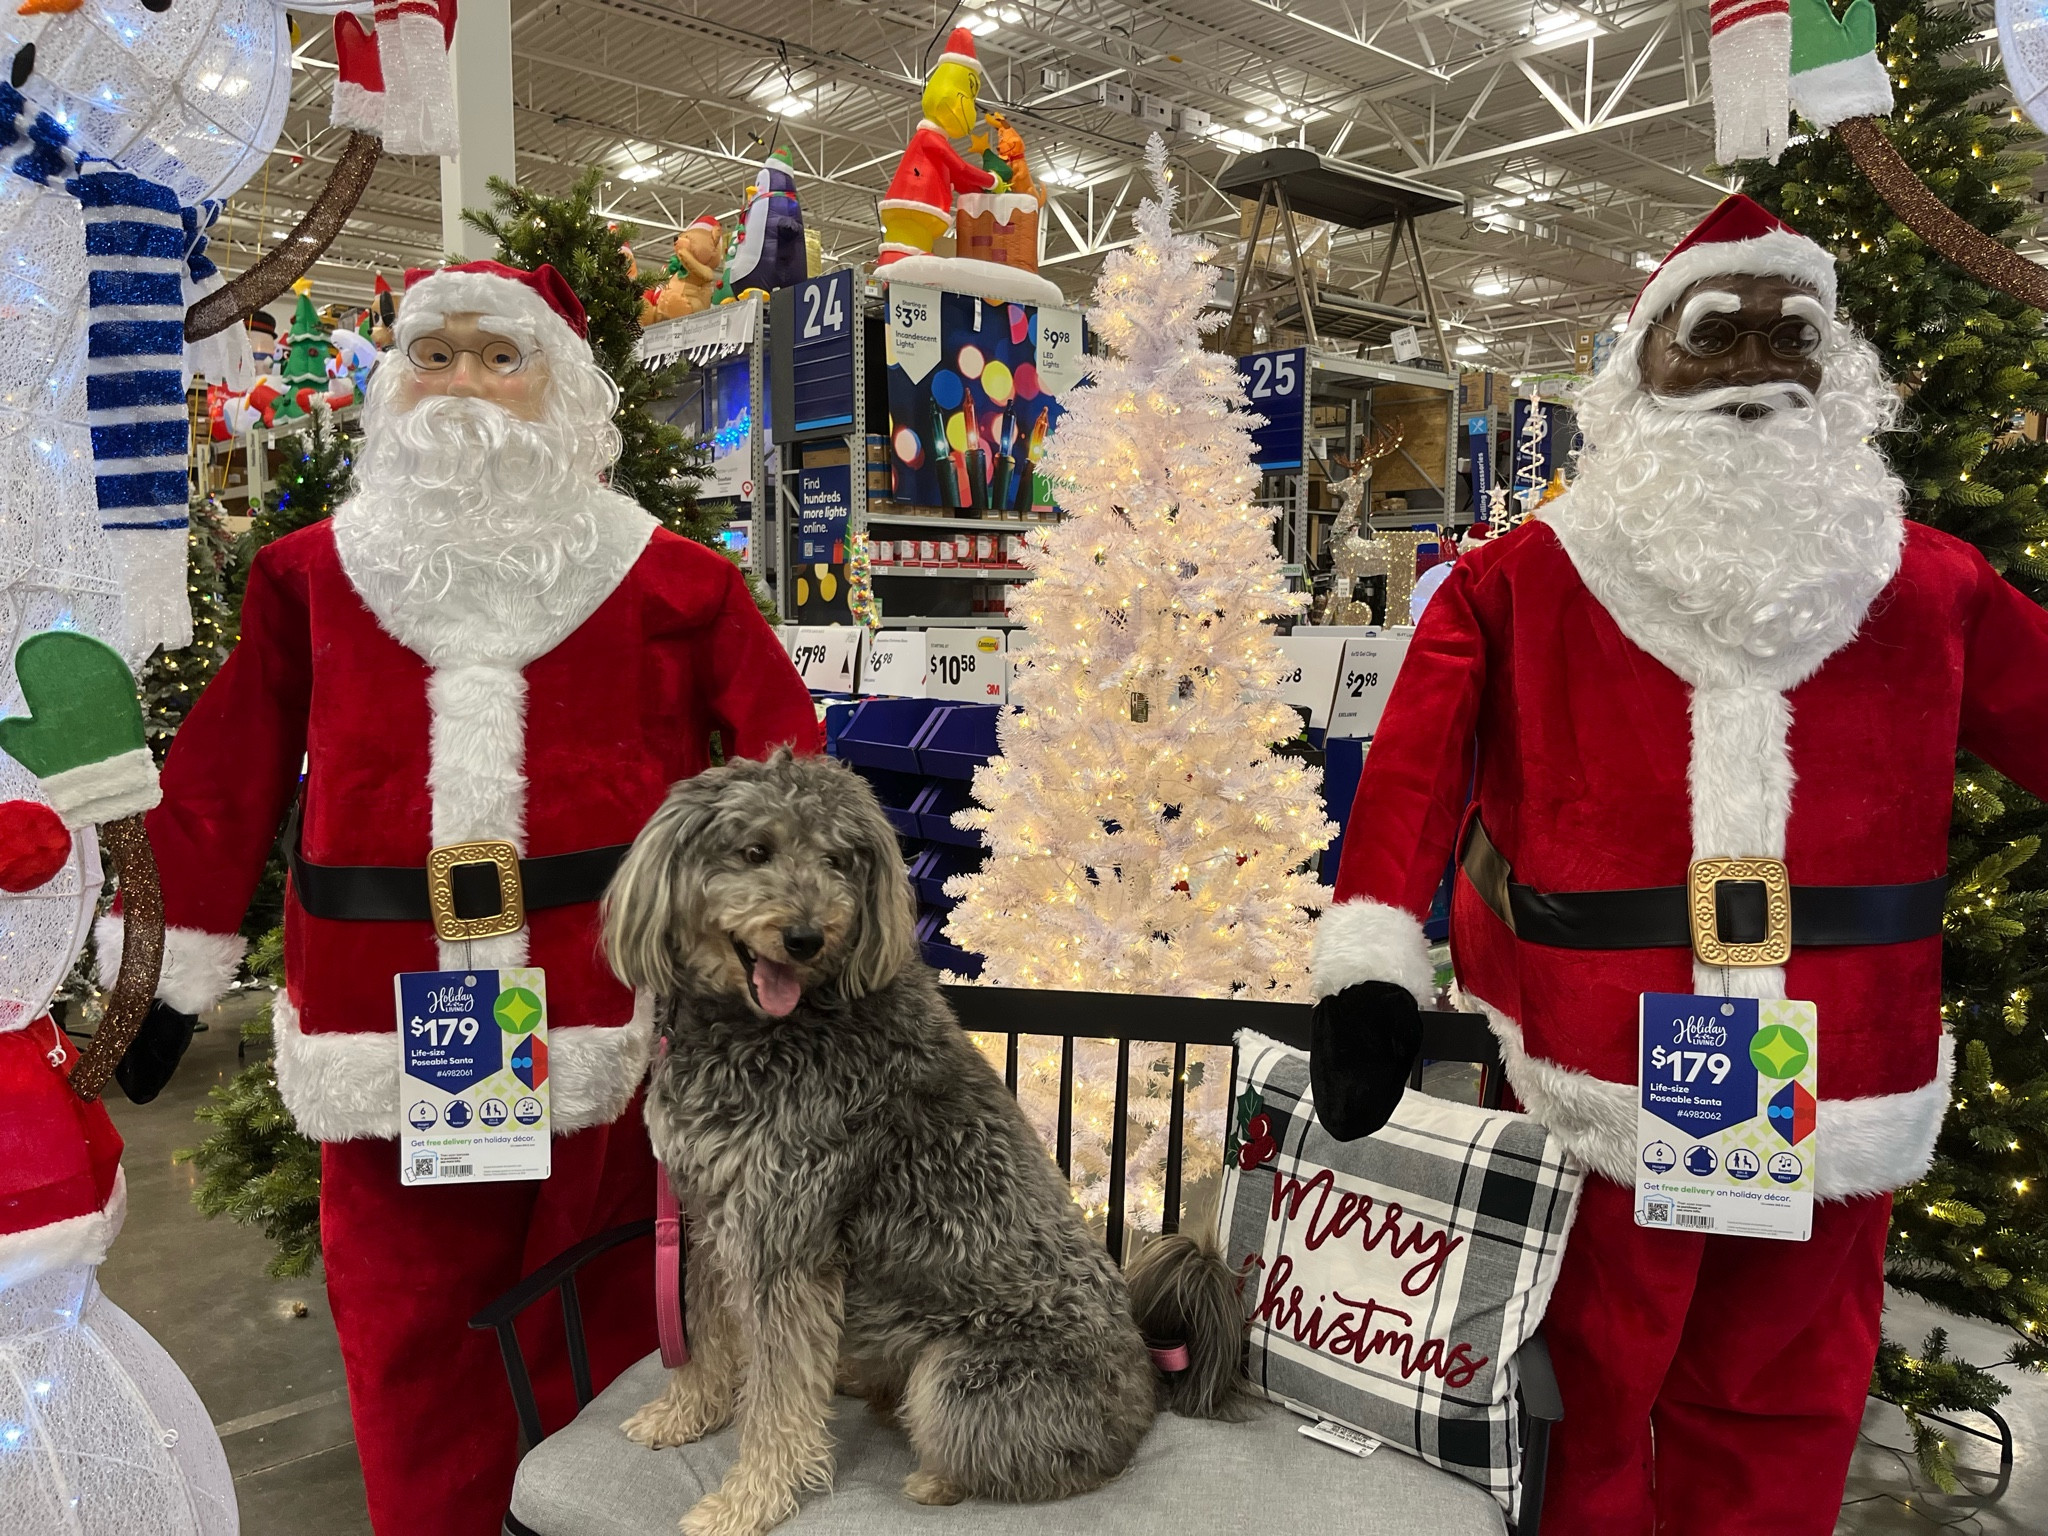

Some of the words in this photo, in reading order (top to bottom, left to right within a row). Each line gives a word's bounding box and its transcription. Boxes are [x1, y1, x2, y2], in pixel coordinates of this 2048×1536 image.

[803, 277, 844, 339] 24
[902, 300, 921, 308] Starting
[895, 304, 927, 328] $398
[895, 331, 937, 343] Incandescent
[1043, 328, 1070, 349] $998
[1042, 351, 1054, 360] LED
[1042, 360, 1060, 369] Lights
[1252, 353, 1296, 399] 25
[1476, 452, 1486, 494] Accessories
[803, 477, 820, 489] Find
[803, 491, 841, 504] hundreds
[803, 509, 824, 518] more
[824, 506, 847, 520] lights
[1480, 495, 1488, 521] Grilling
[803, 522, 828, 534] online.
[794, 645, 826, 676] $798
[870, 651, 893, 672] $698
[930, 655, 976, 685] $1058
[986, 684, 1000, 695] 3M
[1346, 670, 1378, 698] $298
[427, 986, 474, 1014] Holiday
[411, 1016, 479, 1047] $179
[1672, 1016, 1728, 1047] Holiday
[1692, 1038, 1715, 1046] LIVING
[411, 1048, 446, 1057] Life-size
[411, 1058, 448, 1067] Poseable
[449, 1057, 474, 1065] Santa
[1651, 1045, 1731, 1085] $179
[436, 1069, 473, 1078] #4982061
[1650, 1083, 1690, 1093] Life-size
[1650, 1093, 1692, 1105] Poseable
[1693, 1096, 1722, 1107] Santa
[419, 1107, 426, 1116] 6
[1677, 1109, 1722, 1121] #4982062
[411, 1139, 425, 1147] Get
[426, 1138, 441, 1146] free
[442, 1137, 472, 1146] delivery
[484, 1136, 512, 1144] holiday
[512, 1135, 536, 1143] décor.
[1656, 1148, 1663, 1157] 6
[1643, 1182, 1660, 1190] Get
[1661, 1183, 1679, 1192] free
[1680, 1185, 1715, 1196] delivery
[1729, 1190, 1762, 1200] holiday
[1763, 1193, 1792, 1202] décor.
[1271, 1169, 1464, 1296] Merry
